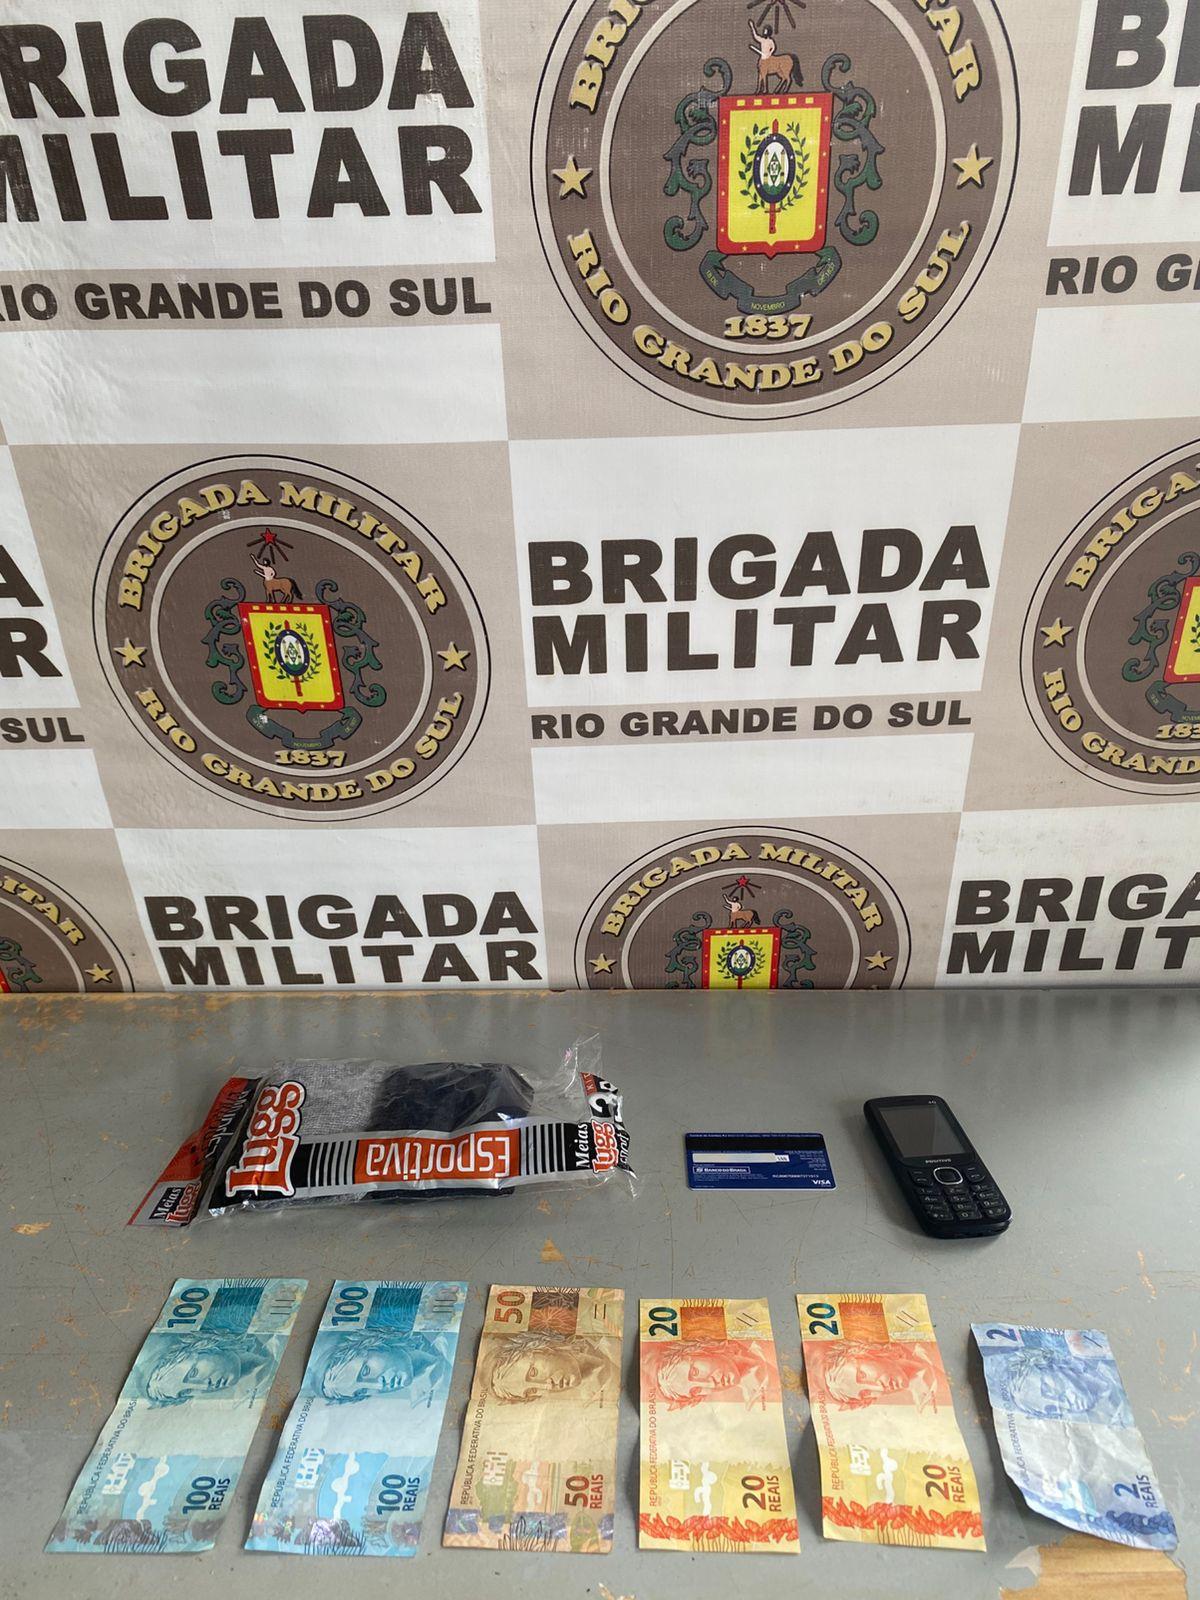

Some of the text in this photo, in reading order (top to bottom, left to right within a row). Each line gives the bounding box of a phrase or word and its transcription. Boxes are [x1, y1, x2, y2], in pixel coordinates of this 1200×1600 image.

[1045, 255, 1138, 296] RIO
[0, 276, 492, 321] IO GRANDE DO SUL
[567, 220, 971, 391] RIO GRANDE DO SUL
[724, 313, 814, 339] 1837
[118, 479, 272, 612] BRIGADA
[278, 481, 448, 615] MILITAR
[1065, 463, 1200, 591] BRIGA
[527, 525, 989, 606] BRIGADA
[531, 599, 981, 676] MILITAR
[1043, 667, 1083, 732] RIO
[0, 718, 85, 743] SUL
[531, 700, 972, 740] RIO GRANDE DO SUL
[135, 687, 464, 802] RIO GRANDE DO SUL
[274, 749, 347, 768] 1837
[601, 843, 884, 936] BRIGADA MILITAR
[0, 875, 86, 945] ITAR
[143, 891, 538, 941] BRIGADA
[158, 939, 543, 986] MILITAR
[226, 1081, 305, 1198] Lugg
[366, 1134, 510, 1180] Esportiva
[574, 1123, 590, 1168] Meias
[153, 1187, 182, 1219] Meias
[167, 1287, 210, 1328] 100
[332, 1287, 368, 1327] 100
[493, 1290, 526, 1325] 50
[648, 1306, 678, 1337] 20
[806, 1302, 839, 1337] 20
[986, 1328, 1018, 1343] 2
[183, 1475, 216, 1514] 100
[208, 1477, 231, 1510] REAIS
[377, 1474, 406, 1516] 100
[401, 1477, 420, 1512] REAIS
[564, 1474, 591, 1508] 50
[589, 1473, 604, 1509] REAIS
[741, 1474, 766, 1511] 20
[769, 1474, 779, 1513] REAIS
[922, 1463, 950, 1500] 20
[953, 1465, 966, 1504] REAIS
[1114, 1483, 1139, 1499] 2
[1138, 1475, 1155, 1509] REAIS
